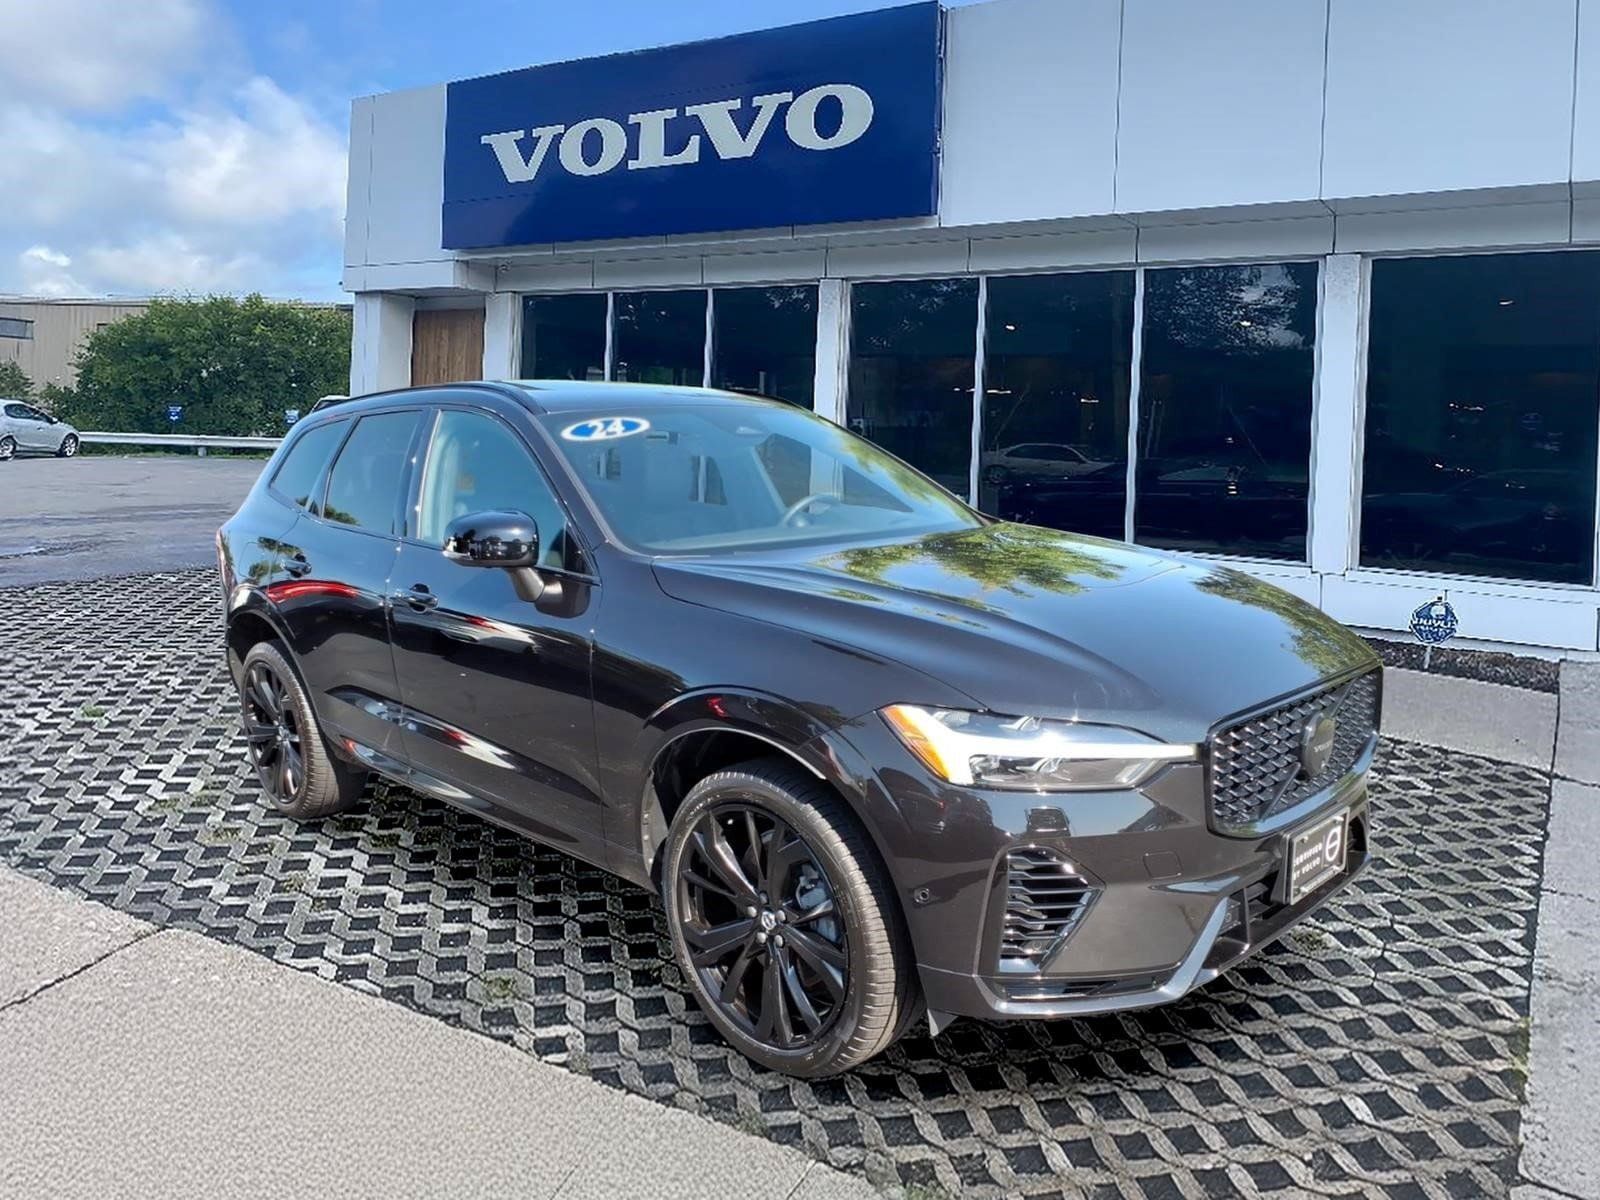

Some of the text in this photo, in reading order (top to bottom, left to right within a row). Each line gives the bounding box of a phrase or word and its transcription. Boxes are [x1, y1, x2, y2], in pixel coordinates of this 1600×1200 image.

[481, 83, 875, 184] VOLVO
[588, 418, 625, 438] 24
[1301, 856, 1321, 874] VOLVO
